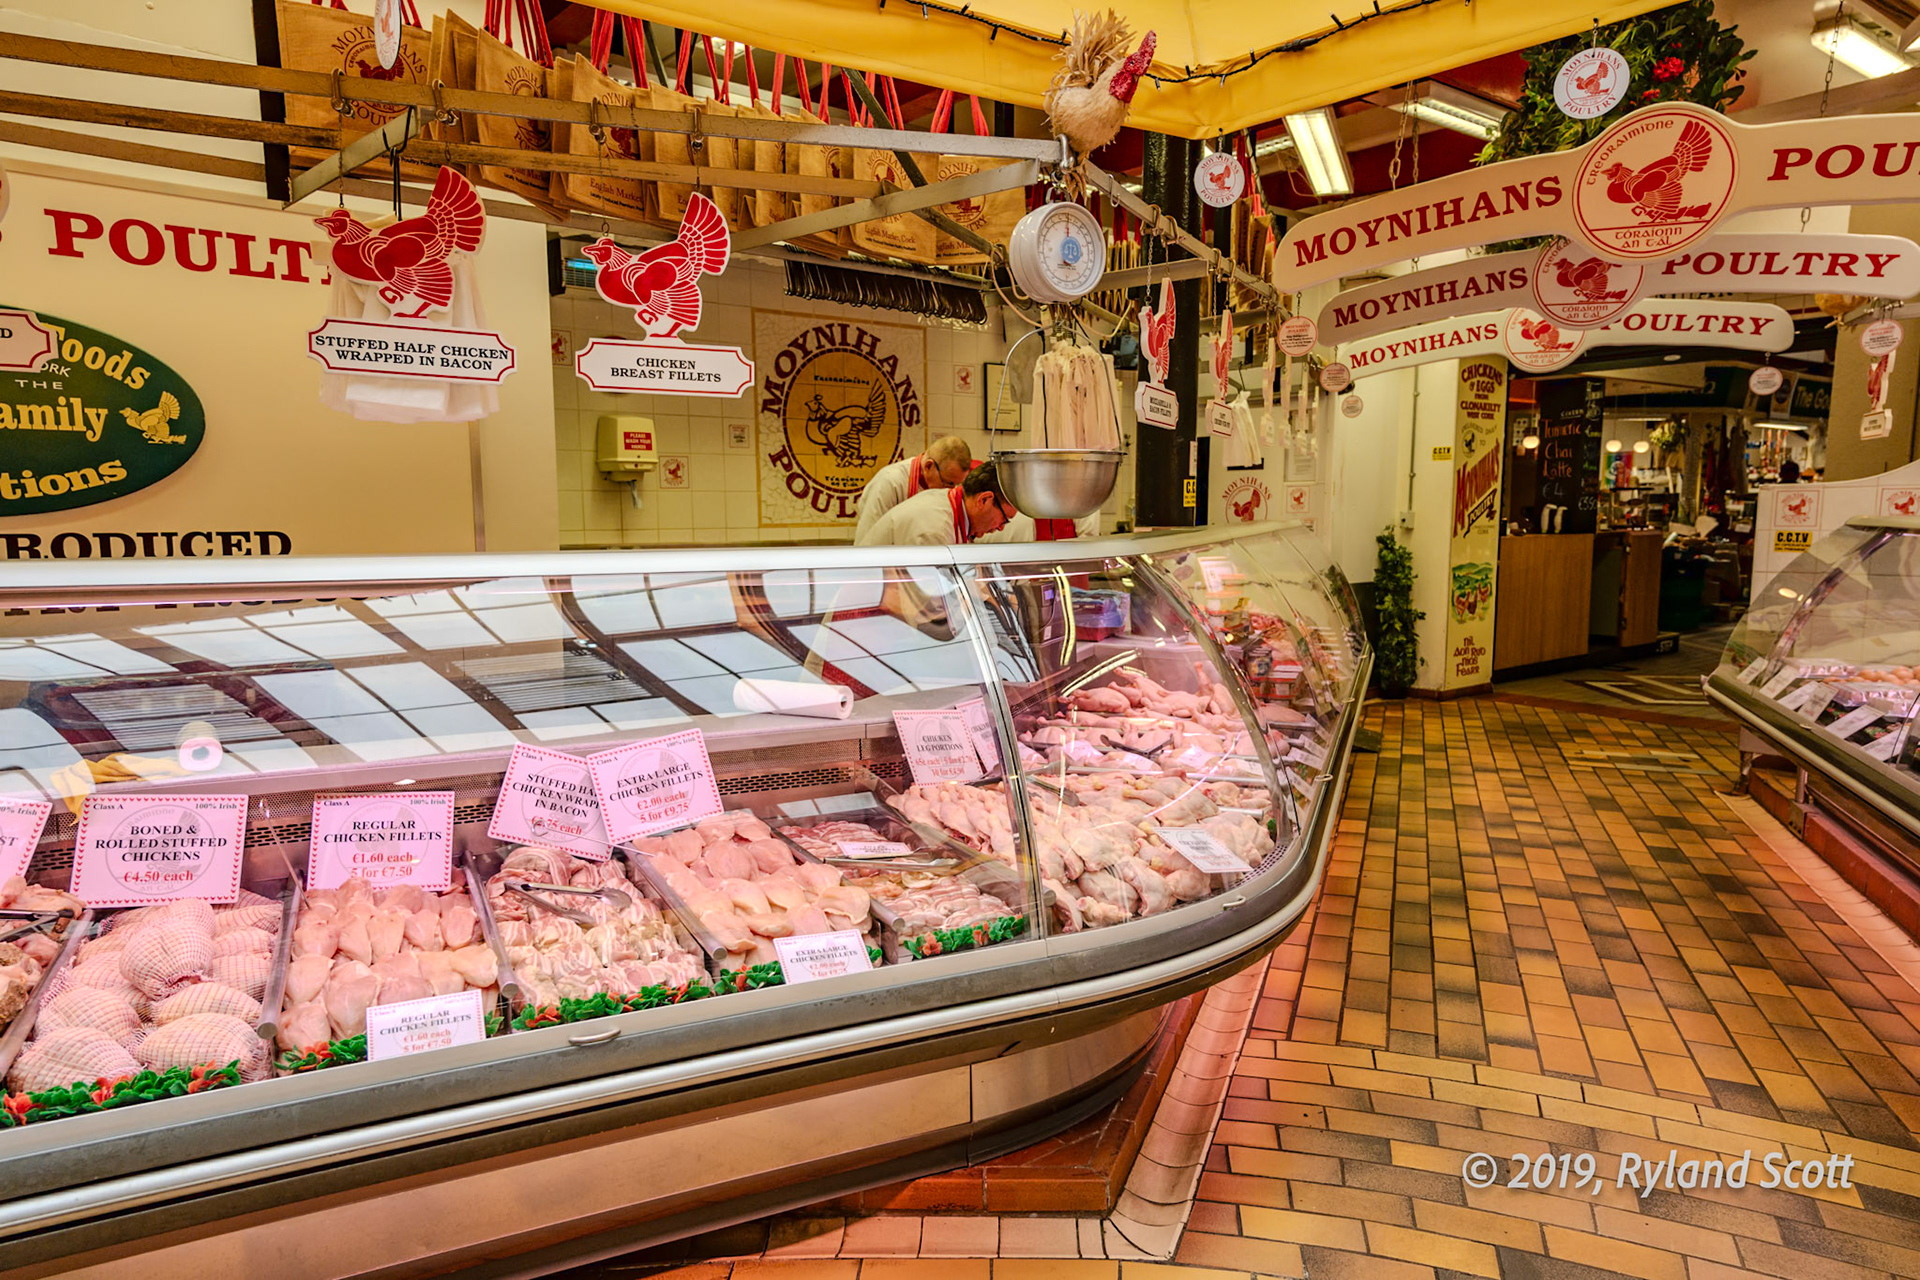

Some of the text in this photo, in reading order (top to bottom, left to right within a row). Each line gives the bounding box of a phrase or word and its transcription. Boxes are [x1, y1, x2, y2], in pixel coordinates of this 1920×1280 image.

[331, 26, 427, 75] MOYNANS
[1562, 51, 1623, 77] MOYNHANS
[1563, 94, 1617, 115] POULTRY
[1767, 140, 1920, 182] POU
[1200, 189, 1236, 204] POULTRY
[1293, 175, 1563, 268] MOYNIHANS
[44, 208, 332, 285] POULT
[900, 234, 917, 245] Cork
[1661, 252, 1901, 278] POULTRY
[1332, 267, 1529, 329] MOYNIHANS
[315, 335, 509, 360] STUFFED HALF CHICKEN
[1350, 323, 1499, 370] MOYNIHANS
[335, 350, 493, 371] WRAPPED IN BACON
[636, 357, 697, 370] CHICKEN
[41, 363, 71, 378] ORK
[611, 367, 722, 383] BREAST FILLETS
[761, 323, 921, 428] MOYNIHANS
[1461, 363, 1504, 387] CHICKENS
[15, 379, 64, 391] THE
[1476, 380, 1495, 393] EGGS
[1460, 400, 1501, 413] CLONAKILTY
[1542, 462, 1572, 479] Latte
[767, 444, 904, 519] POUL
[922, 735, 953, 743] CHICKEN
[931, 743, 964, 751] PORTIONS
[521, 752, 537, 761] Class
[597, 757, 613, 766] Class
[617, 762, 691, 789] EXTRA LARGE
[526, 773, 598, 798] STUFFED HA
[609, 771, 704, 802] CHICKEN FILLETS
[430, 798, 446, 806] Irish
[512, 782, 600, 810] CHICKEN WRAP
[637, 790, 686, 811] €2.00 each
[17, 807, 38, 816] Irish
[93, 803, 115, 811] Class
[535, 799, 589, 818] IN BACON
[640, 802, 689, 823] 5 for €9.75
[131, 825, 198, 836] BONED &
[352, 820, 416, 831] REGULAR
[559, 823, 583, 836] each
[95, 837, 228, 850] ROLLED STUFFED
[324, 831, 442, 844] CHICKEN FILLETS
[121, 851, 201, 863] CHICKENS
[352, 852, 413, 864] €1.60 each
[124, 870, 194, 883] €4.50 each
[351, 866, 412, 879] 5 for €7.50
[790, 950, 859, 964] CHICKEN FILLETS
[796, 945, 848, 957] EXTRA LARGE
[380, 1014, 472, 1035] CHICKEN FILLETS
[401, 1010, 450, 1024] REGULAR
[430, 1028, 451, 1037] each
